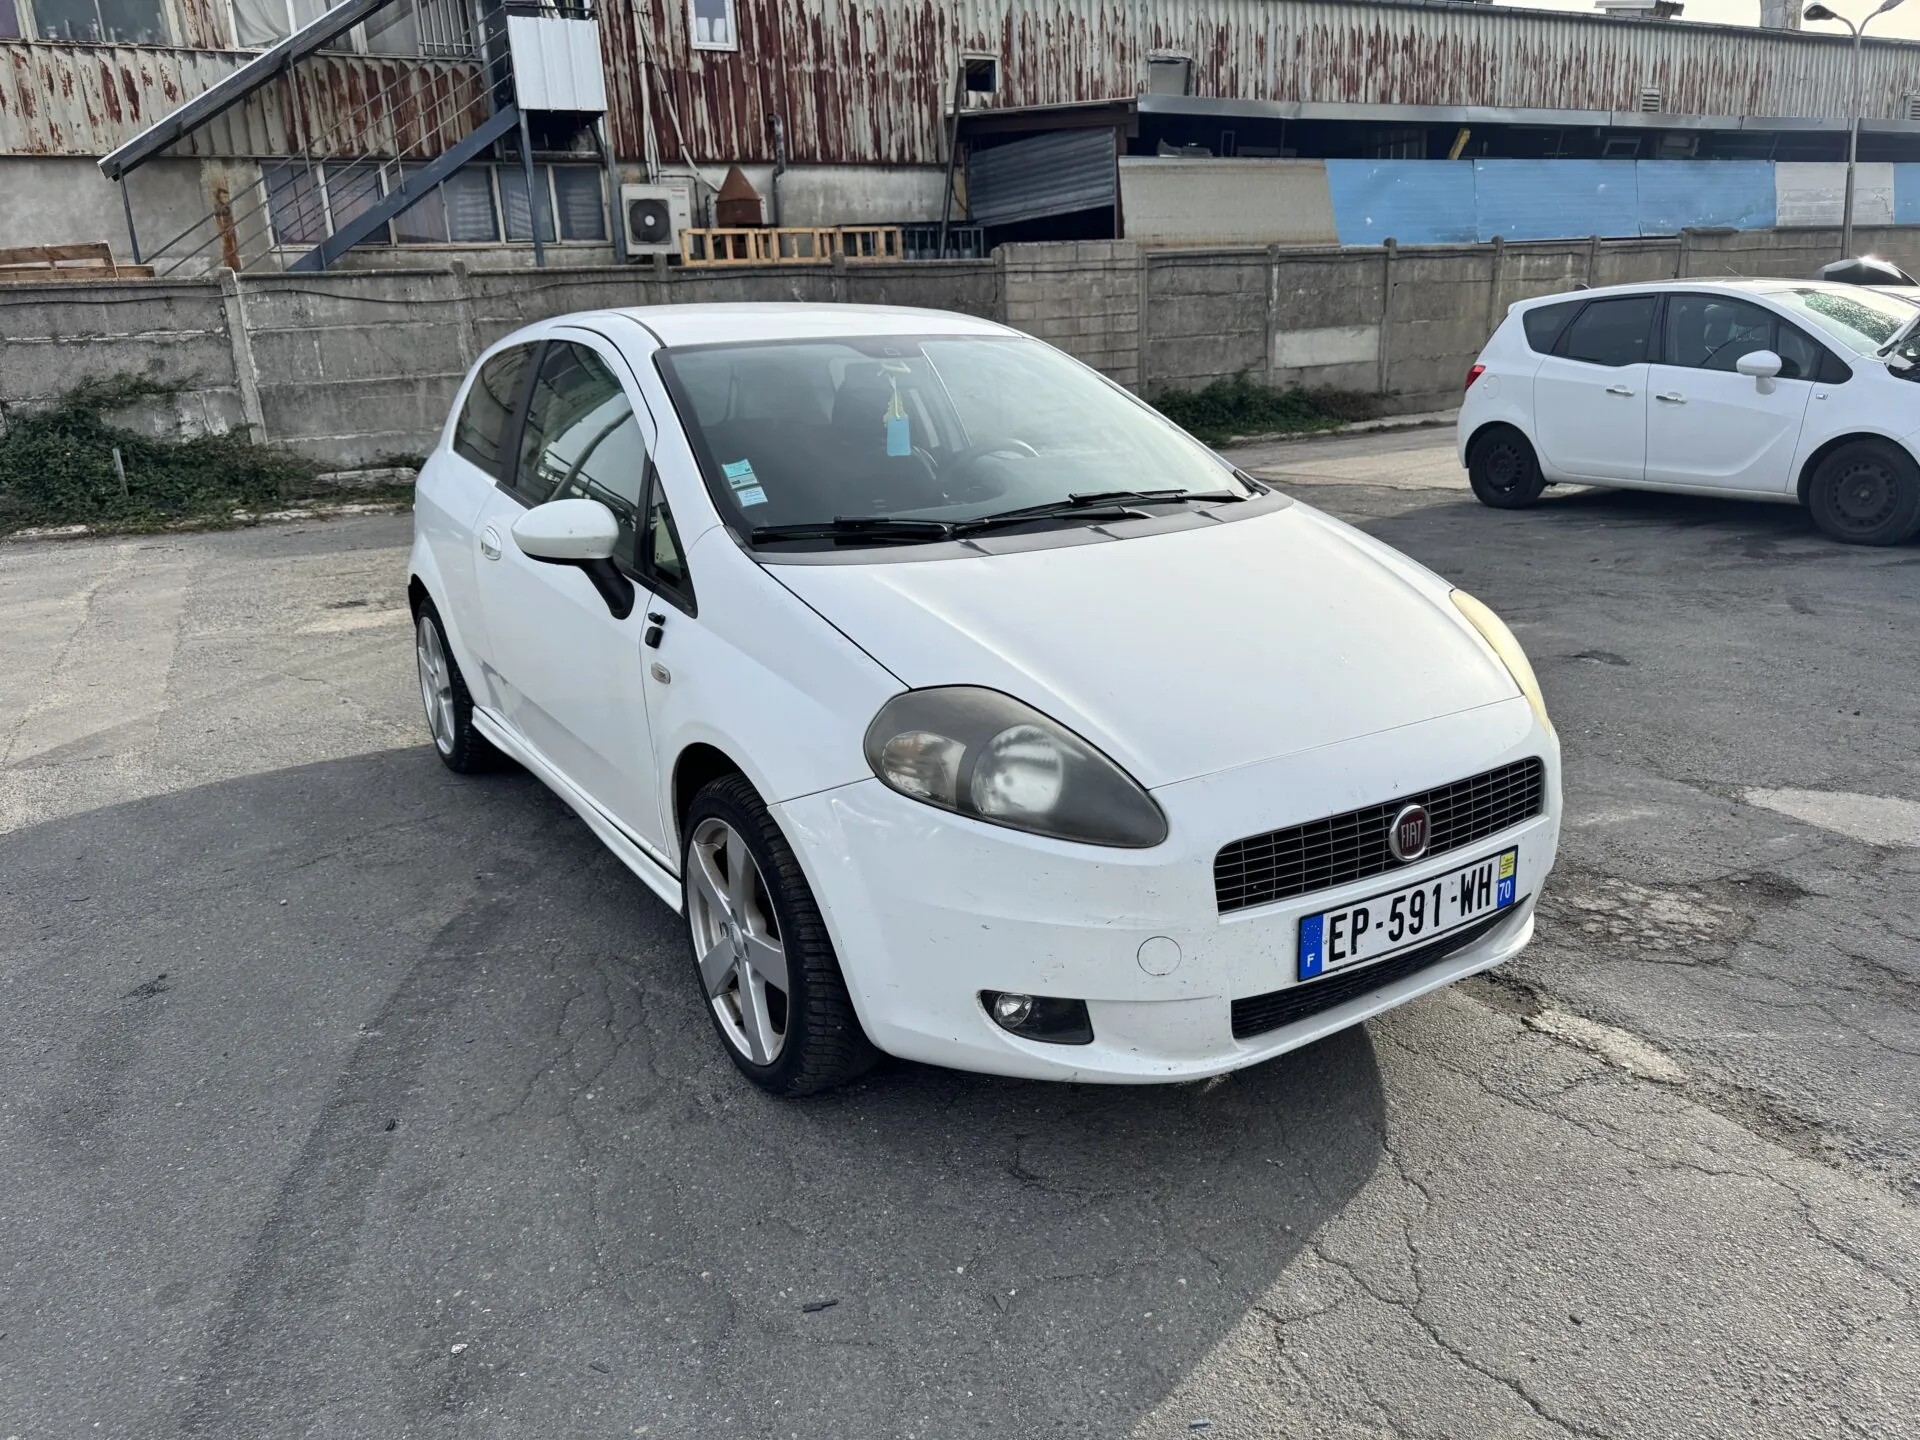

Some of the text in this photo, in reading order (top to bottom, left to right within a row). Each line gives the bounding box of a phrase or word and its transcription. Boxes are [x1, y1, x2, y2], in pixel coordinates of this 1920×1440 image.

[1401, 820, 1423, 849] FIAT
[1499, 880, 1511, 902] 70
[1329, 863, 1493, 962] EP-591-WH
[1307, 953, 1315, 967] F
